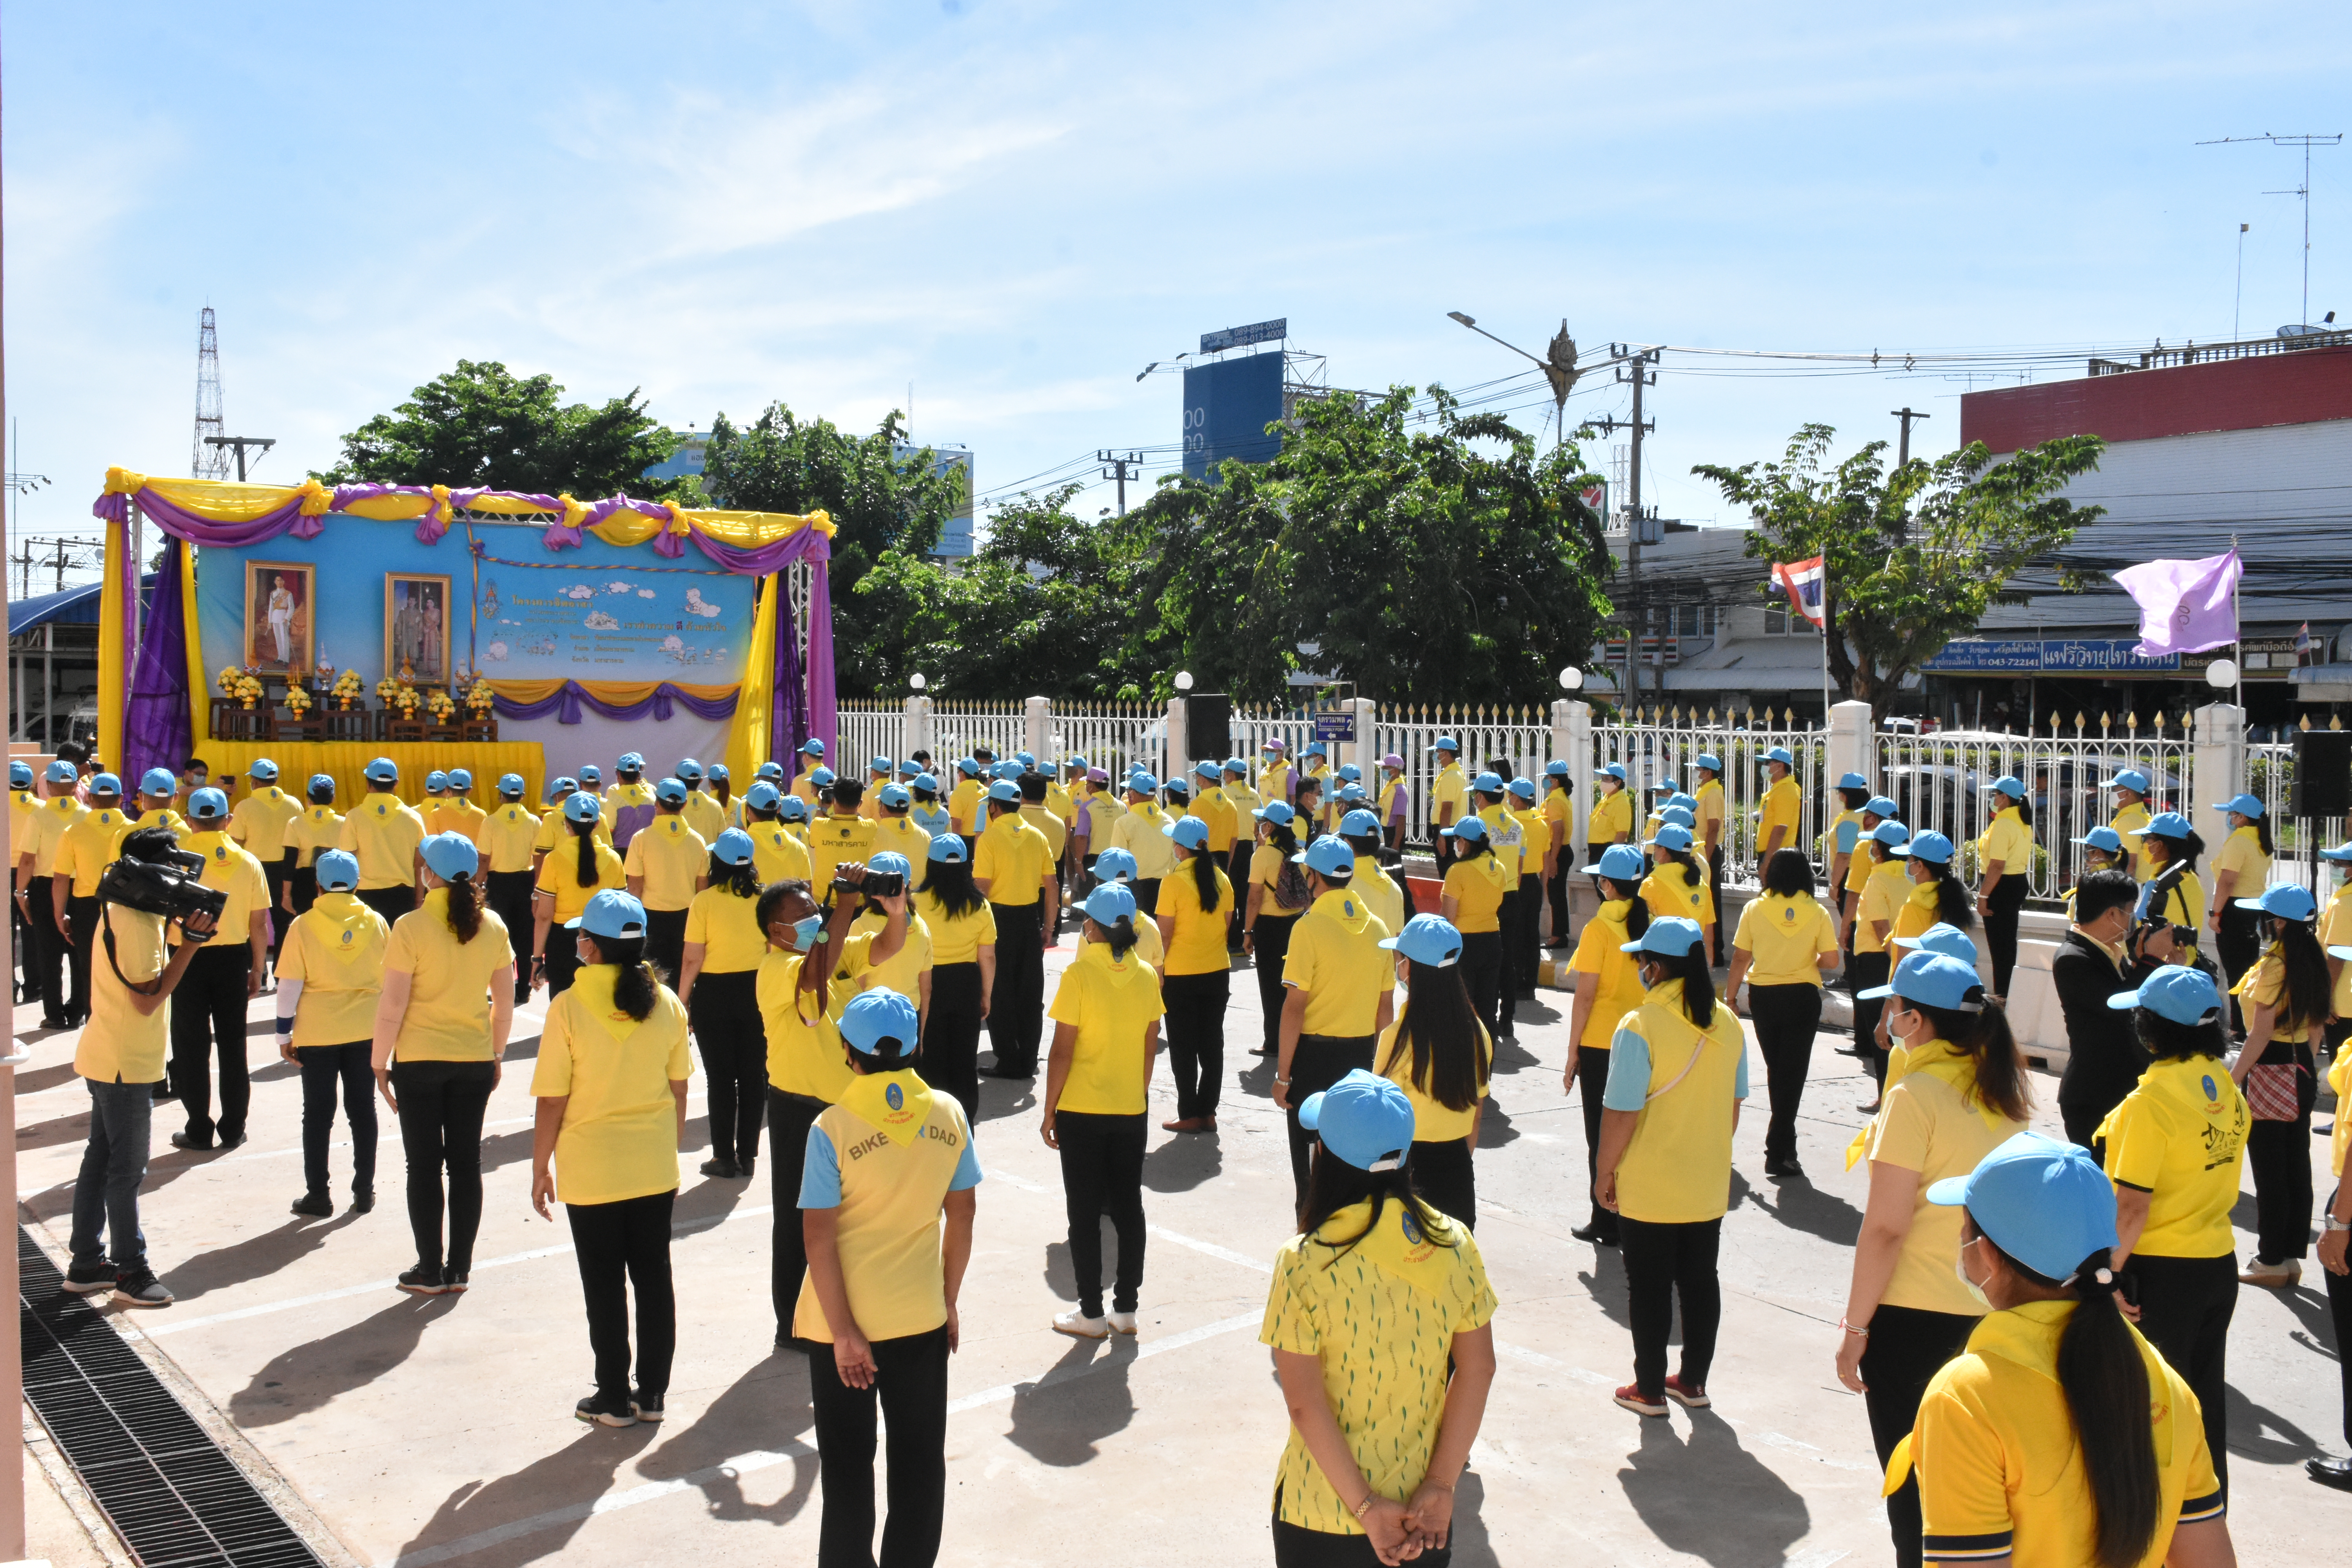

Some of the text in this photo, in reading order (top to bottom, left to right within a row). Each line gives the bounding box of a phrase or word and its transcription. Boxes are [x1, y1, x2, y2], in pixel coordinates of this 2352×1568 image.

[1234, 319, 1285, 337] 089-894-0000
[1234, 328, 1285, 345] 089-013-4000
[1988, 659, 2039, 667] 043-722141
[1317, 717, 1345, 726] จุดรวมพล
[1347, 719, 1353, 731] 2
[822, 839, 868, 848] มหาสารคาม
[849, 1132, 889, 1161] BIKE
[929, 1125, 957, 1147] DAD
